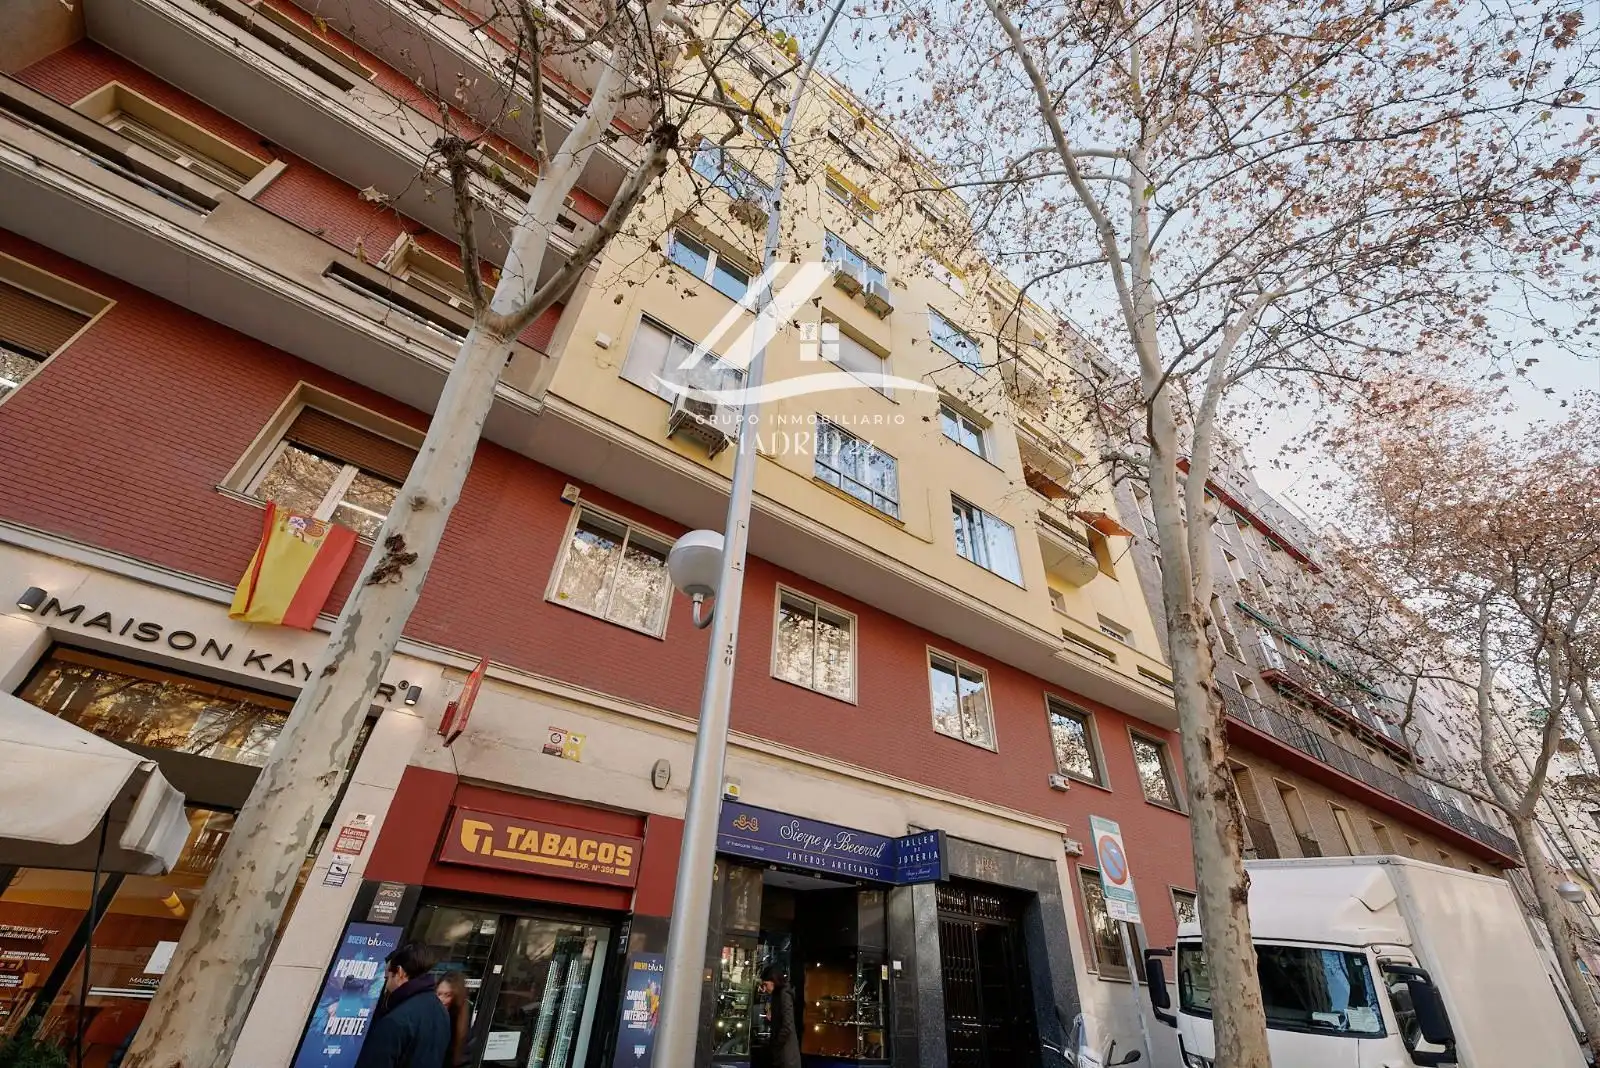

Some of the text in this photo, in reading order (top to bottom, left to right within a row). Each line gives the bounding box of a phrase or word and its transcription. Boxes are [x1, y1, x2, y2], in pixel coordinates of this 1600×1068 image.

[40, 597, 234, 662] MAISON
[342, 827, 367, 838] Alarma
[780, 819, 887, 860] Sierpe y Becerril
[901, 834, 935, 849] TALLER
[506, 826, 633, 867] TABACOS
[786, 852, 880, 877] JOYEROS ARTESANOS
[898, 850, 939, 865] JOYERIA
[626, 989, 647, 1001] SABOR
[324, 1016, 367, 1036] POTENTE
